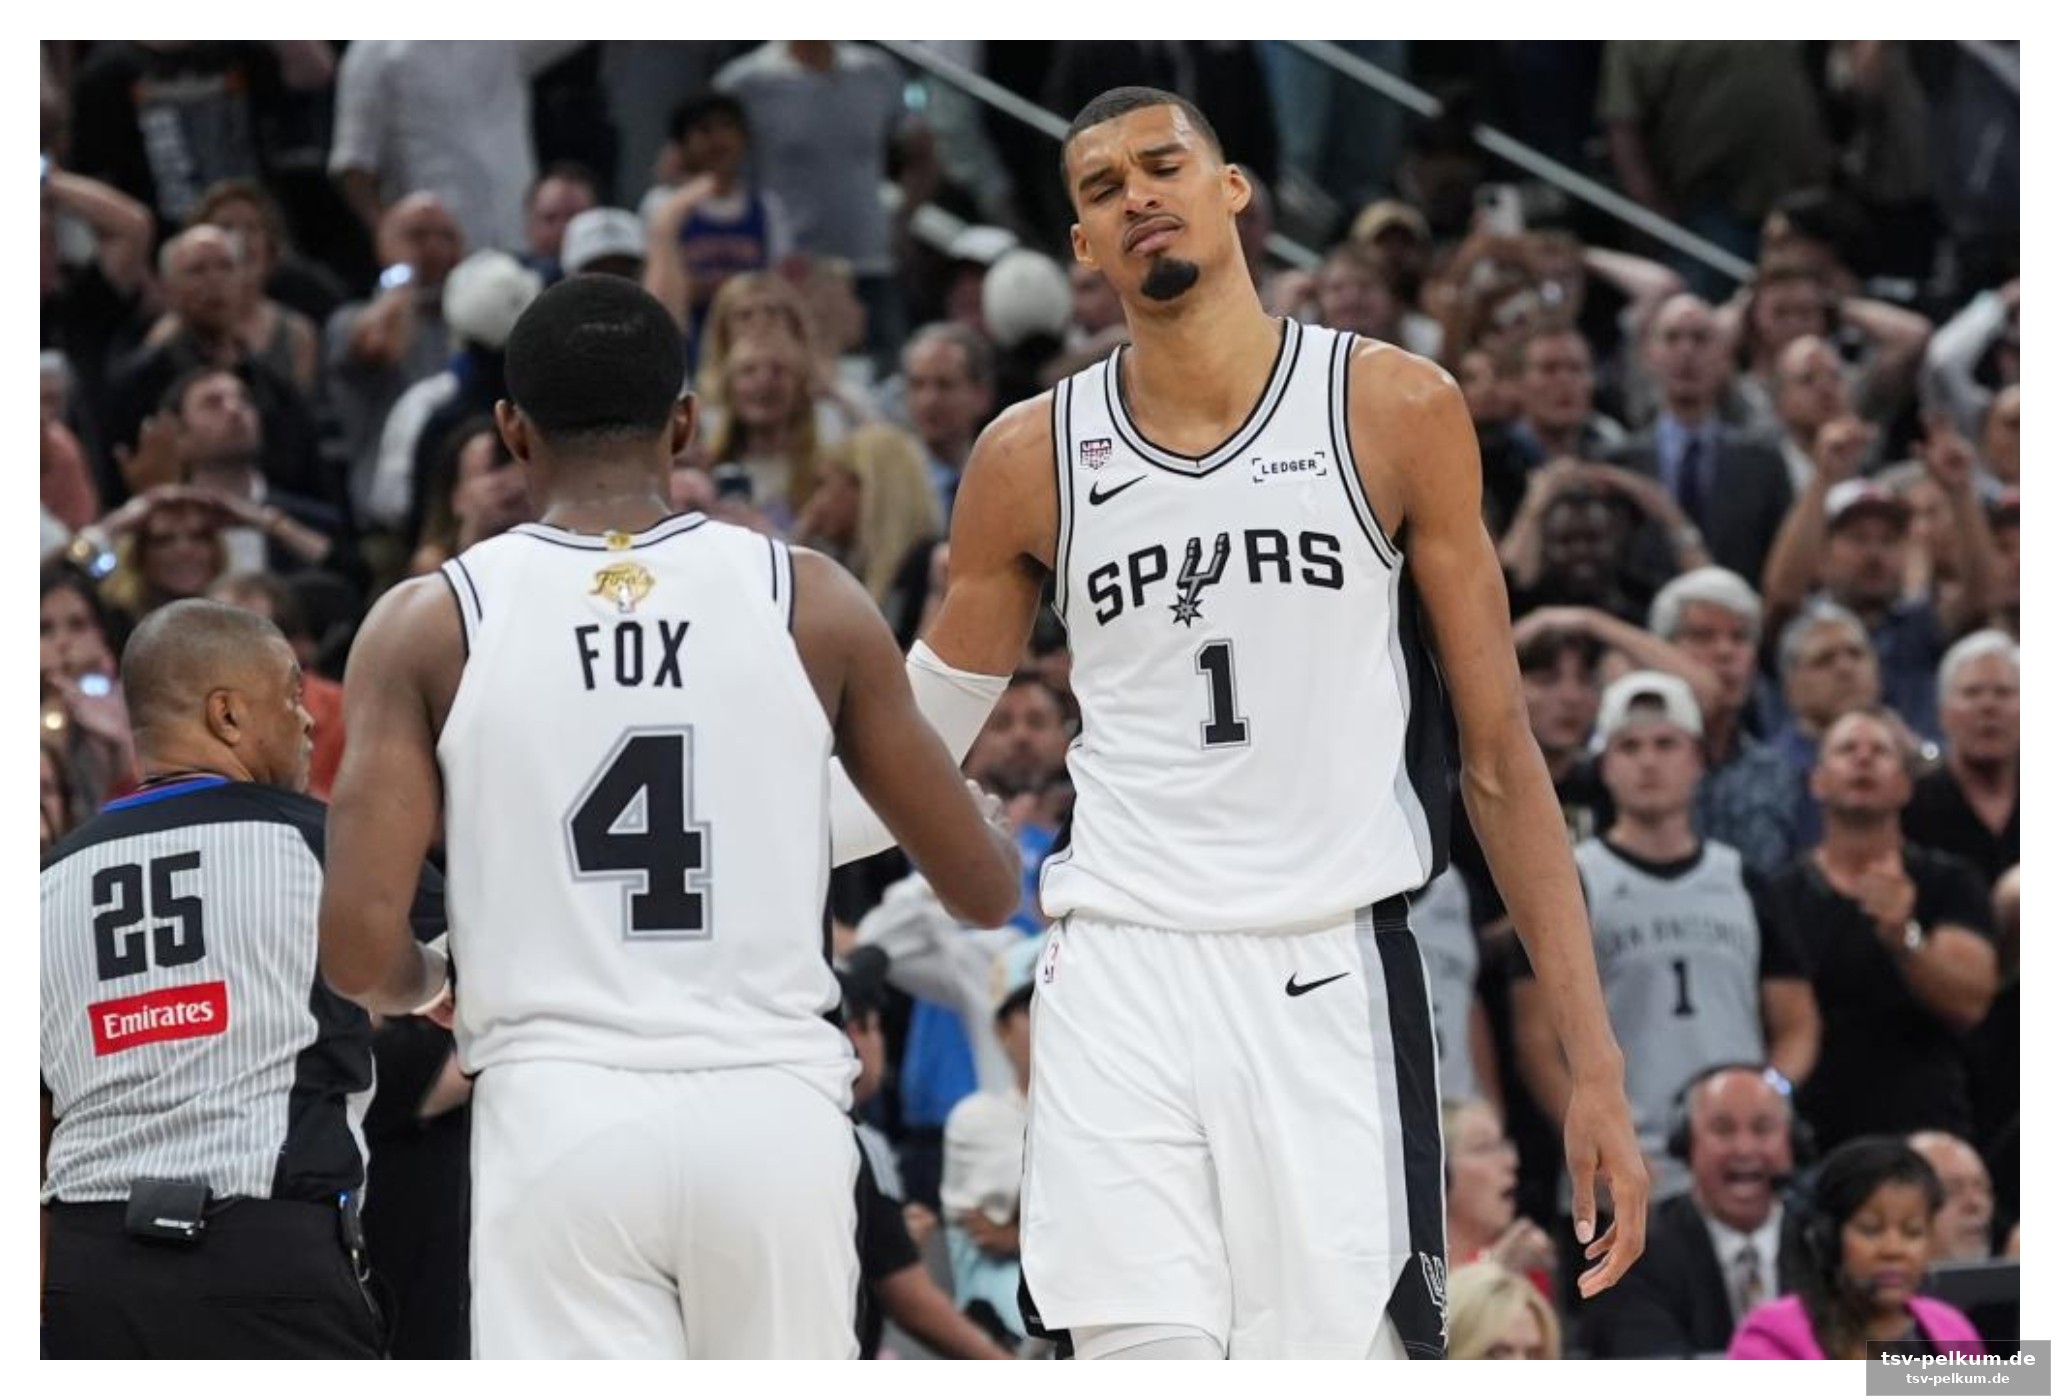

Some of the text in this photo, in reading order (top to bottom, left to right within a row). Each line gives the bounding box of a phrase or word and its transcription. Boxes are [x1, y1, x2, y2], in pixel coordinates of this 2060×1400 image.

[1262, 459, 1317, 474] LEDGER
[1087, 529, 1344, 628] SPURS
[574, 619, 691, 691] FOX
[1194, 638, 1251, 749] 1
[562, 724, 713, 941] 4
[92, 850, 206, 981] 25
[102, 1000, 215, 1040] Emirates
[1670, 956, 1697, 1018] 1
